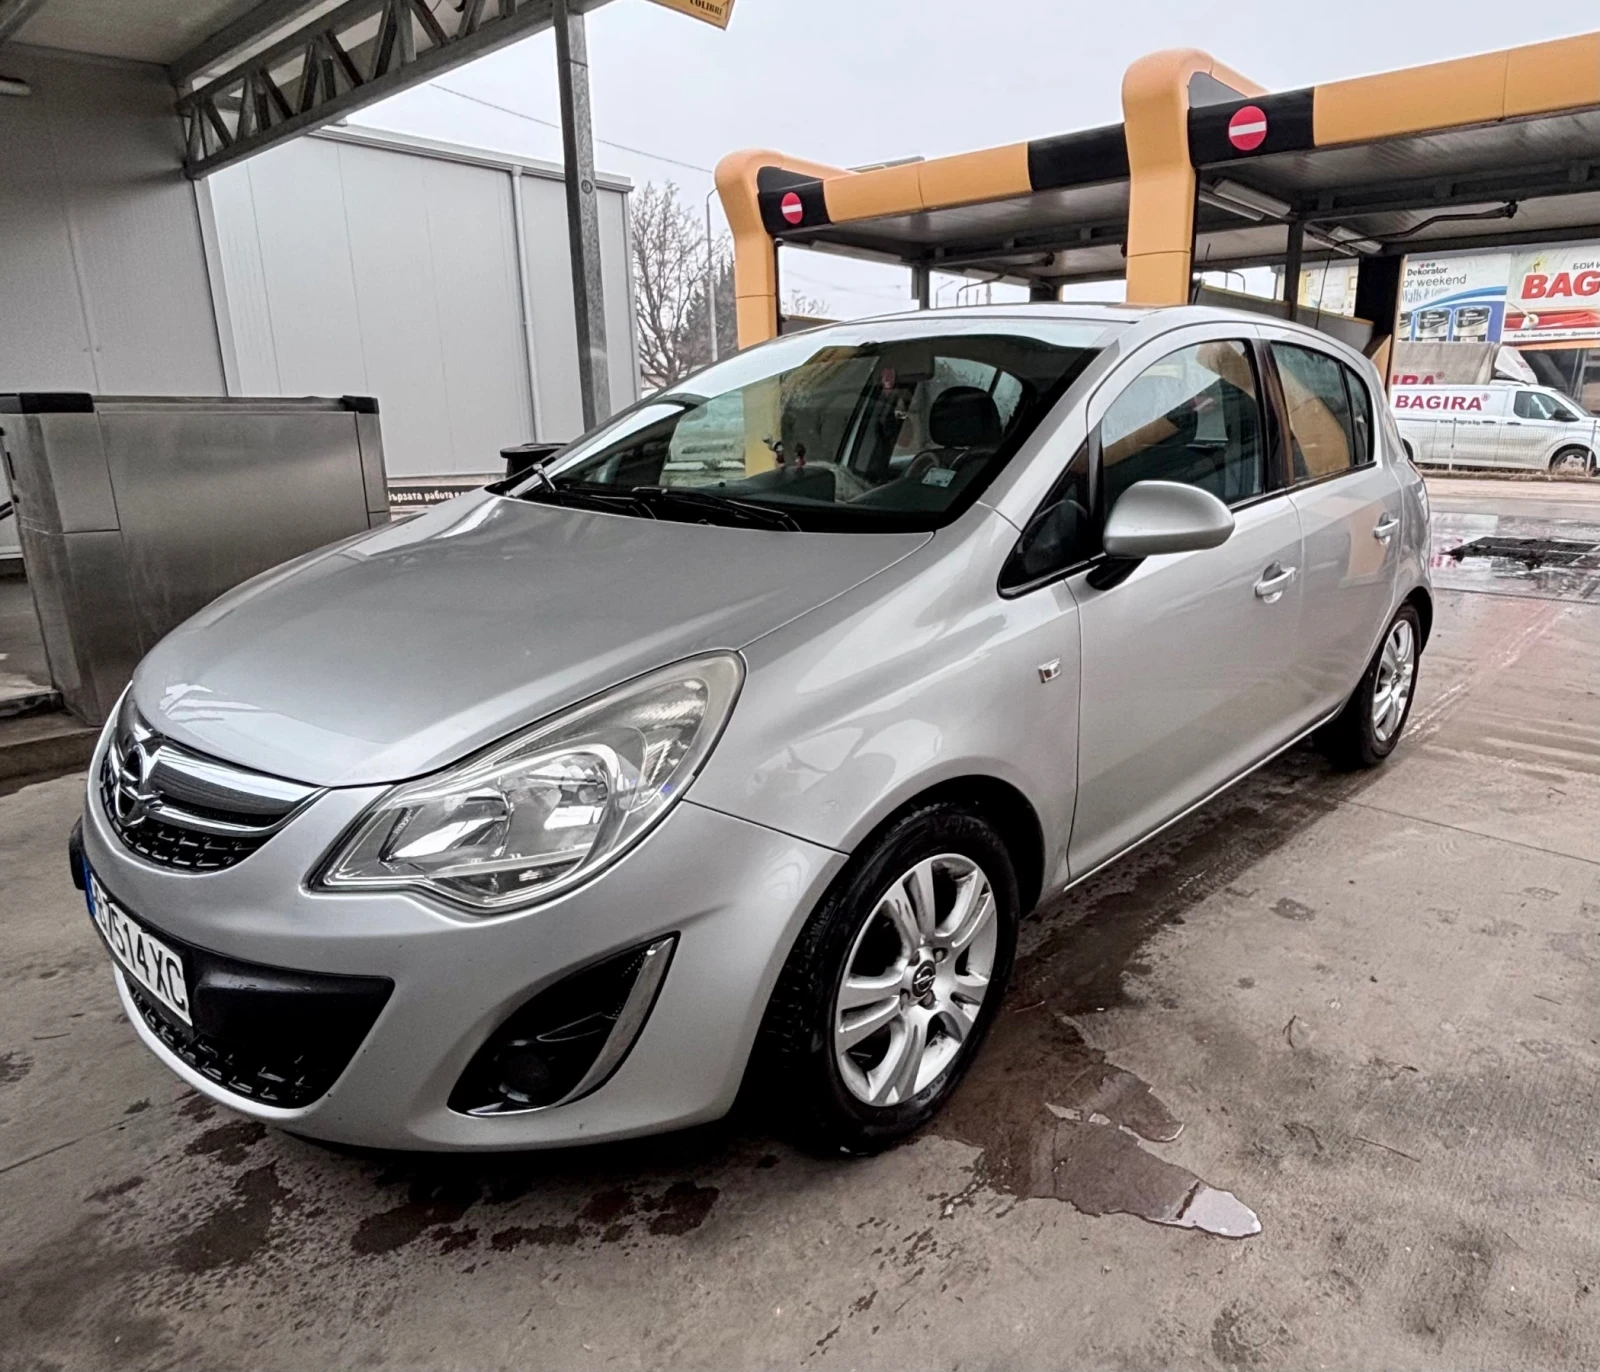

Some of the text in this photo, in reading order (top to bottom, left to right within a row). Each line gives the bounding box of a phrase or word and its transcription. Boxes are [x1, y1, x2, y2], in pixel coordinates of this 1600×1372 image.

[1407, 266, 1448, 276] Dekorator
[1417, 274, 1467, 287] weekend
[1521, 270, 1600, 299] BAG
[1395, 395, 1482, 411] BAGIRA
[424, 489, 454, 502] работа
